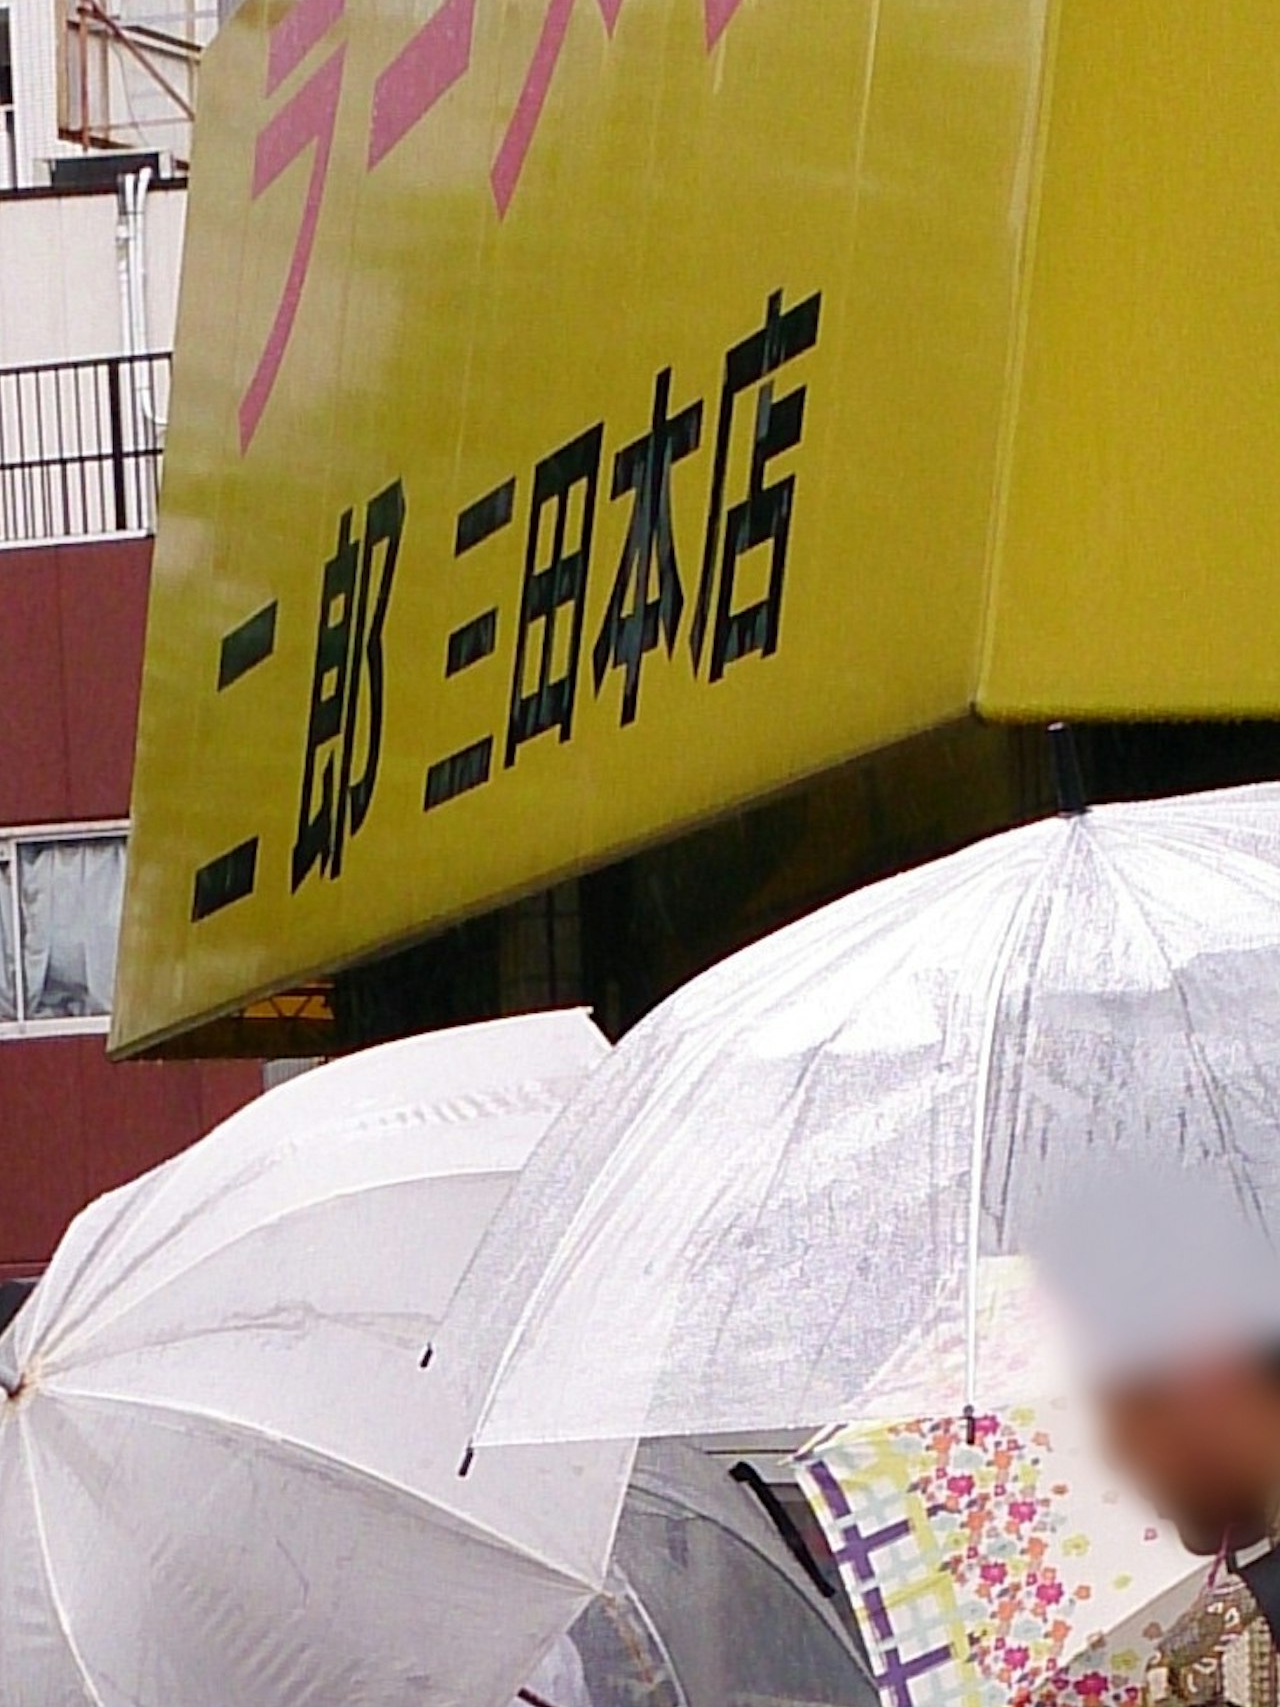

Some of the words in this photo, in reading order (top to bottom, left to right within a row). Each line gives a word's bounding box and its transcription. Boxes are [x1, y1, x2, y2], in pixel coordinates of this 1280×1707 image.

[191, 476, 406, 923] 二郎
[423, 288, 821, 812] 三田本店
